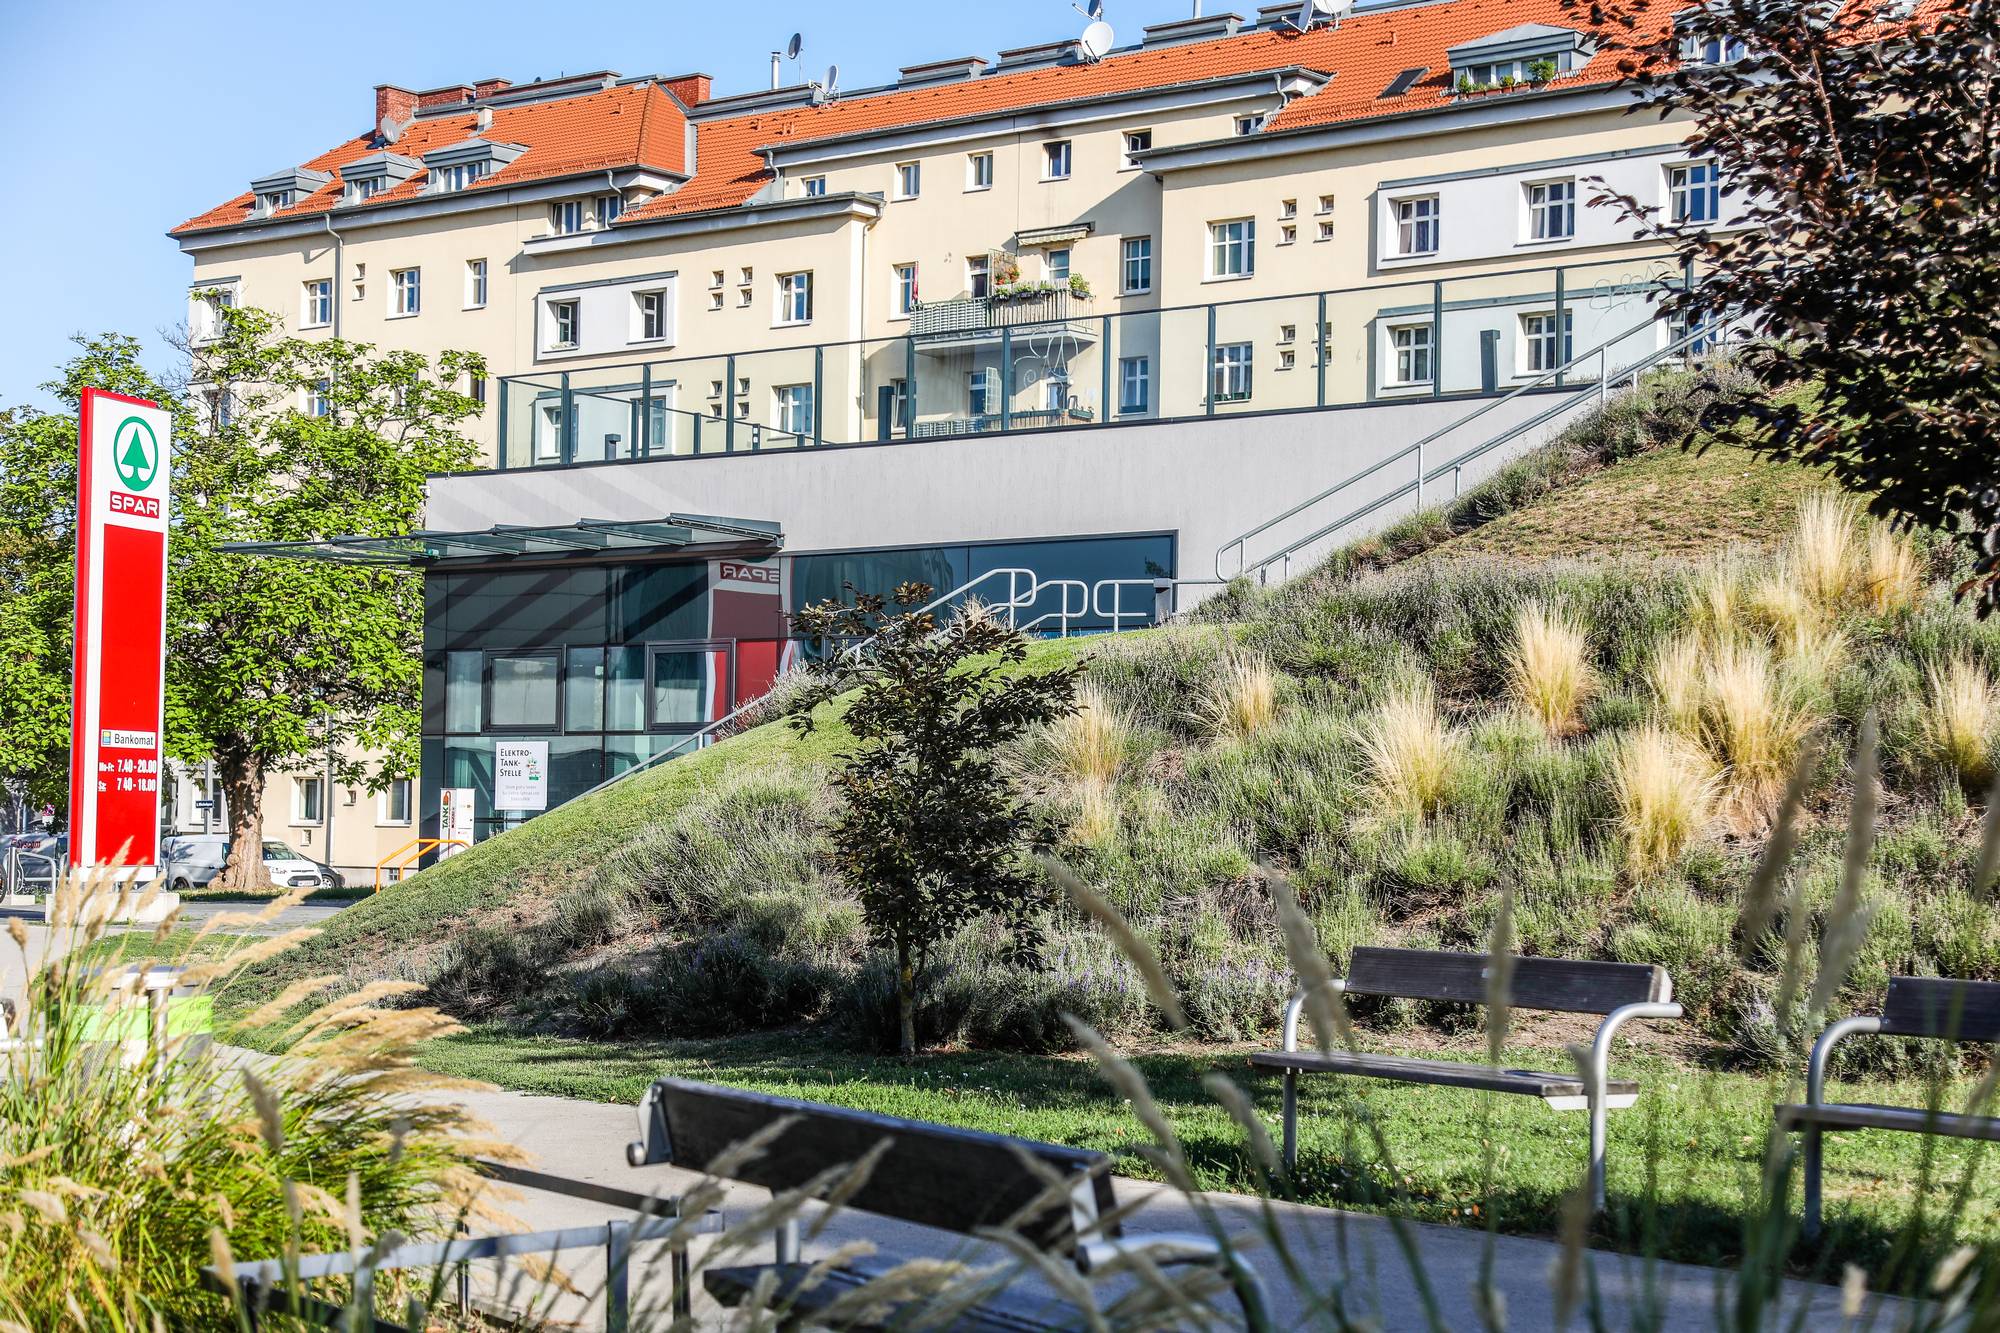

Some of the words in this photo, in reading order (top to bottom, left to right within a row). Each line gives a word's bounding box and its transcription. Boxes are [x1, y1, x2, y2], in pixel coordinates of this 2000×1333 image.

[111, 494, 158, 516] SPAR
[114, 733, 154, 746] Bankomat
[500, 758, 521, 767] TANK-
[500, 768, 522, 777] STELLE
